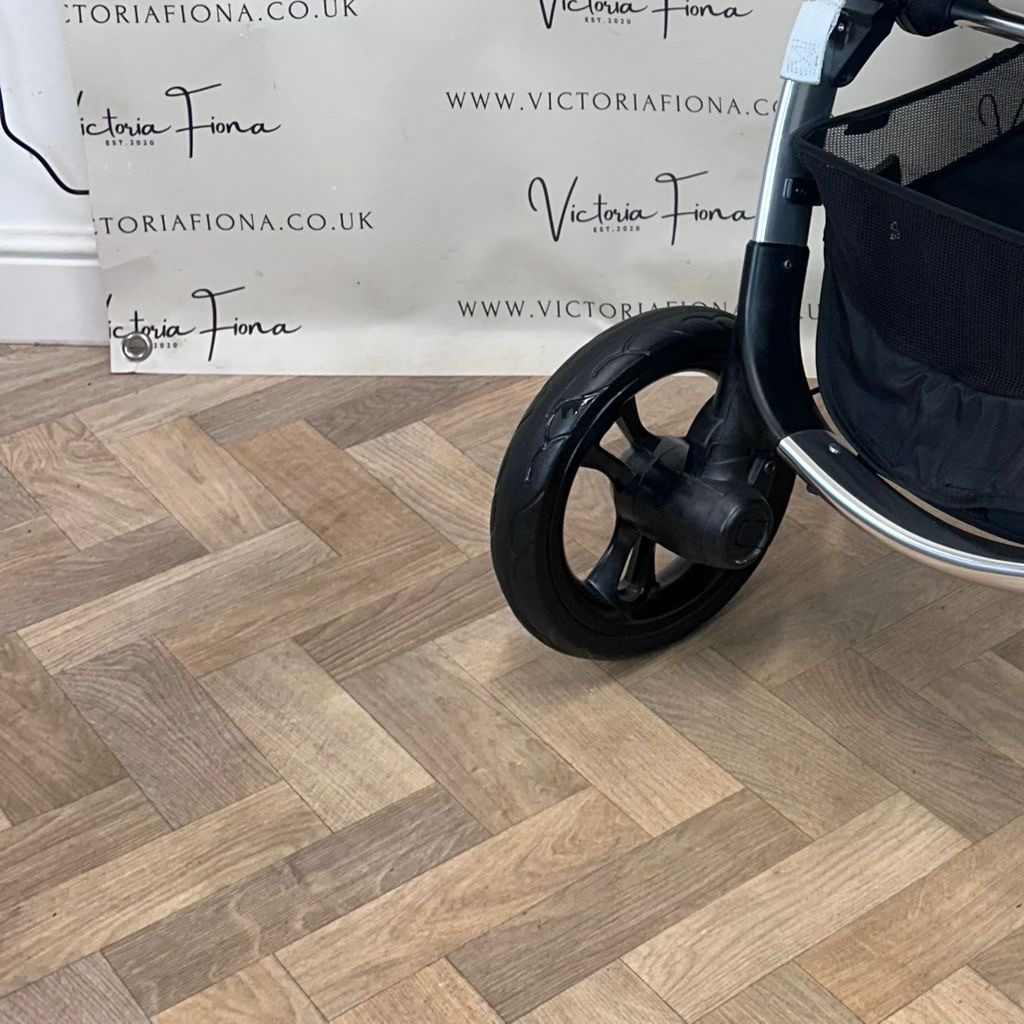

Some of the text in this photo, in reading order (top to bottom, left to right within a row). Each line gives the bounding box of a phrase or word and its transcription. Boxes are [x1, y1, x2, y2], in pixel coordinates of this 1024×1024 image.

[165, 83, 281, 158] Fiona
[446, 92, 777, 117] WWW.VICTORIAFIONA.C
[92, 212, 373, 235] TORIAFIONA.CO.UK
[528, 171, 756, 244] Victoria Fiona
[191, 286, 301, 362] Fiona
